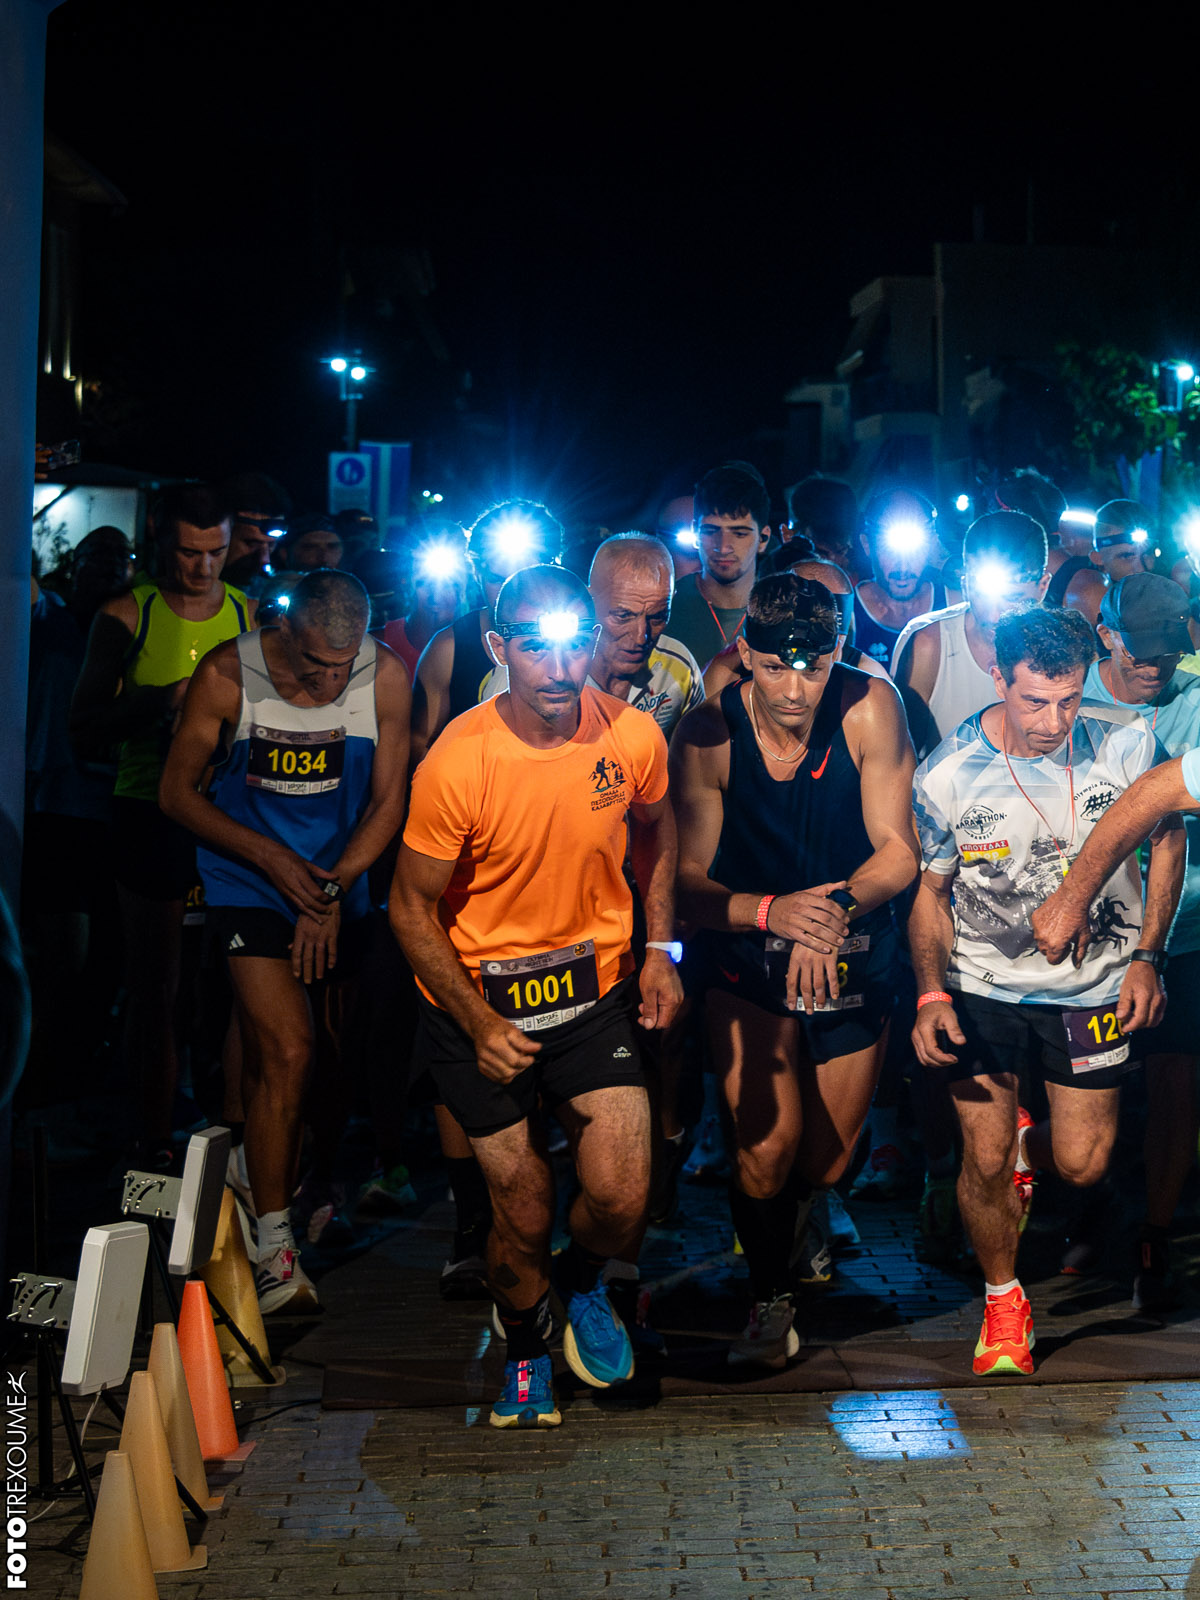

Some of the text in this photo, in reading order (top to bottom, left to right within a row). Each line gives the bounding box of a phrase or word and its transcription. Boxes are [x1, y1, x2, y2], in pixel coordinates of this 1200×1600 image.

[268, 748, 327, 775] 1034
[1073, 782, 1098, 801] Olympia
[507, 969, 574, 1009] 1001
[1087, 1012, 1125, 1044] 12
